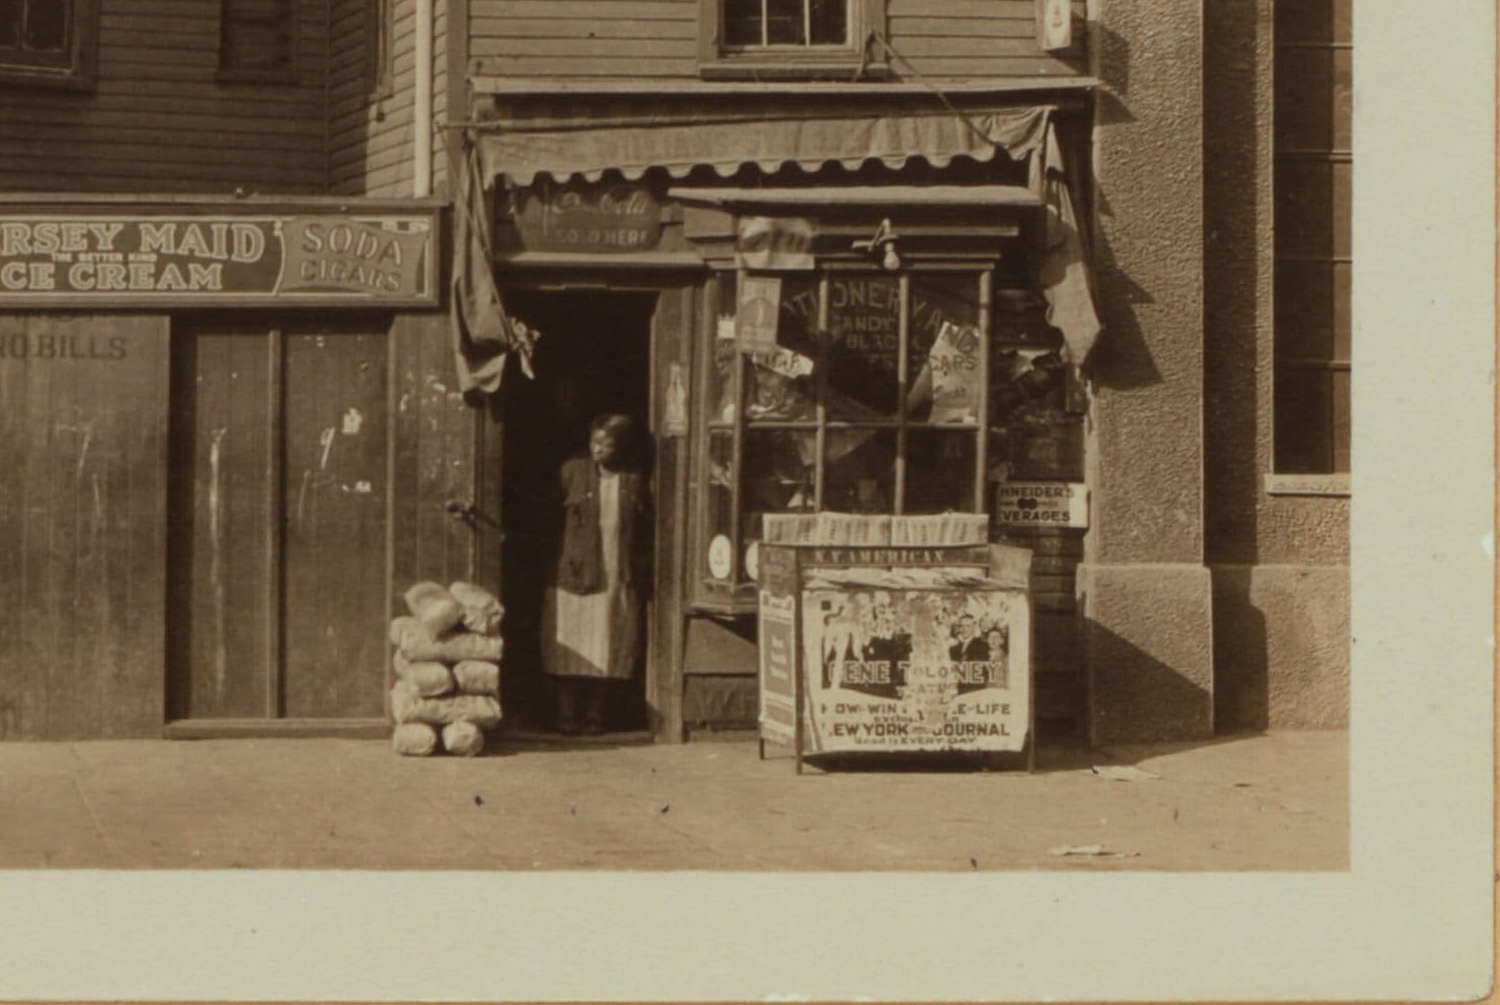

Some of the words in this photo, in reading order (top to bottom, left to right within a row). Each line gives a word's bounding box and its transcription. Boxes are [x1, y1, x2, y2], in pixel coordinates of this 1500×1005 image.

[139, 223, 266, 264] MAID
[302, 223, 402, 266] SODA
[52, 252, 72, 263] THE
[78, 252, 123, 263] BETTER
[128, 252, 158, 263] KIND
[67, 262, 223, 291] CREAM
[300, 258, 401, 293] CIGARS
[36, 335, 128, 360] BILLS
[1002, 510, 1070, 522] VERAGES
[849, 549, 944, 564] AMERICAN
[828, 723, 860, 737] EW
[861, 723, 909, 737] YORK
